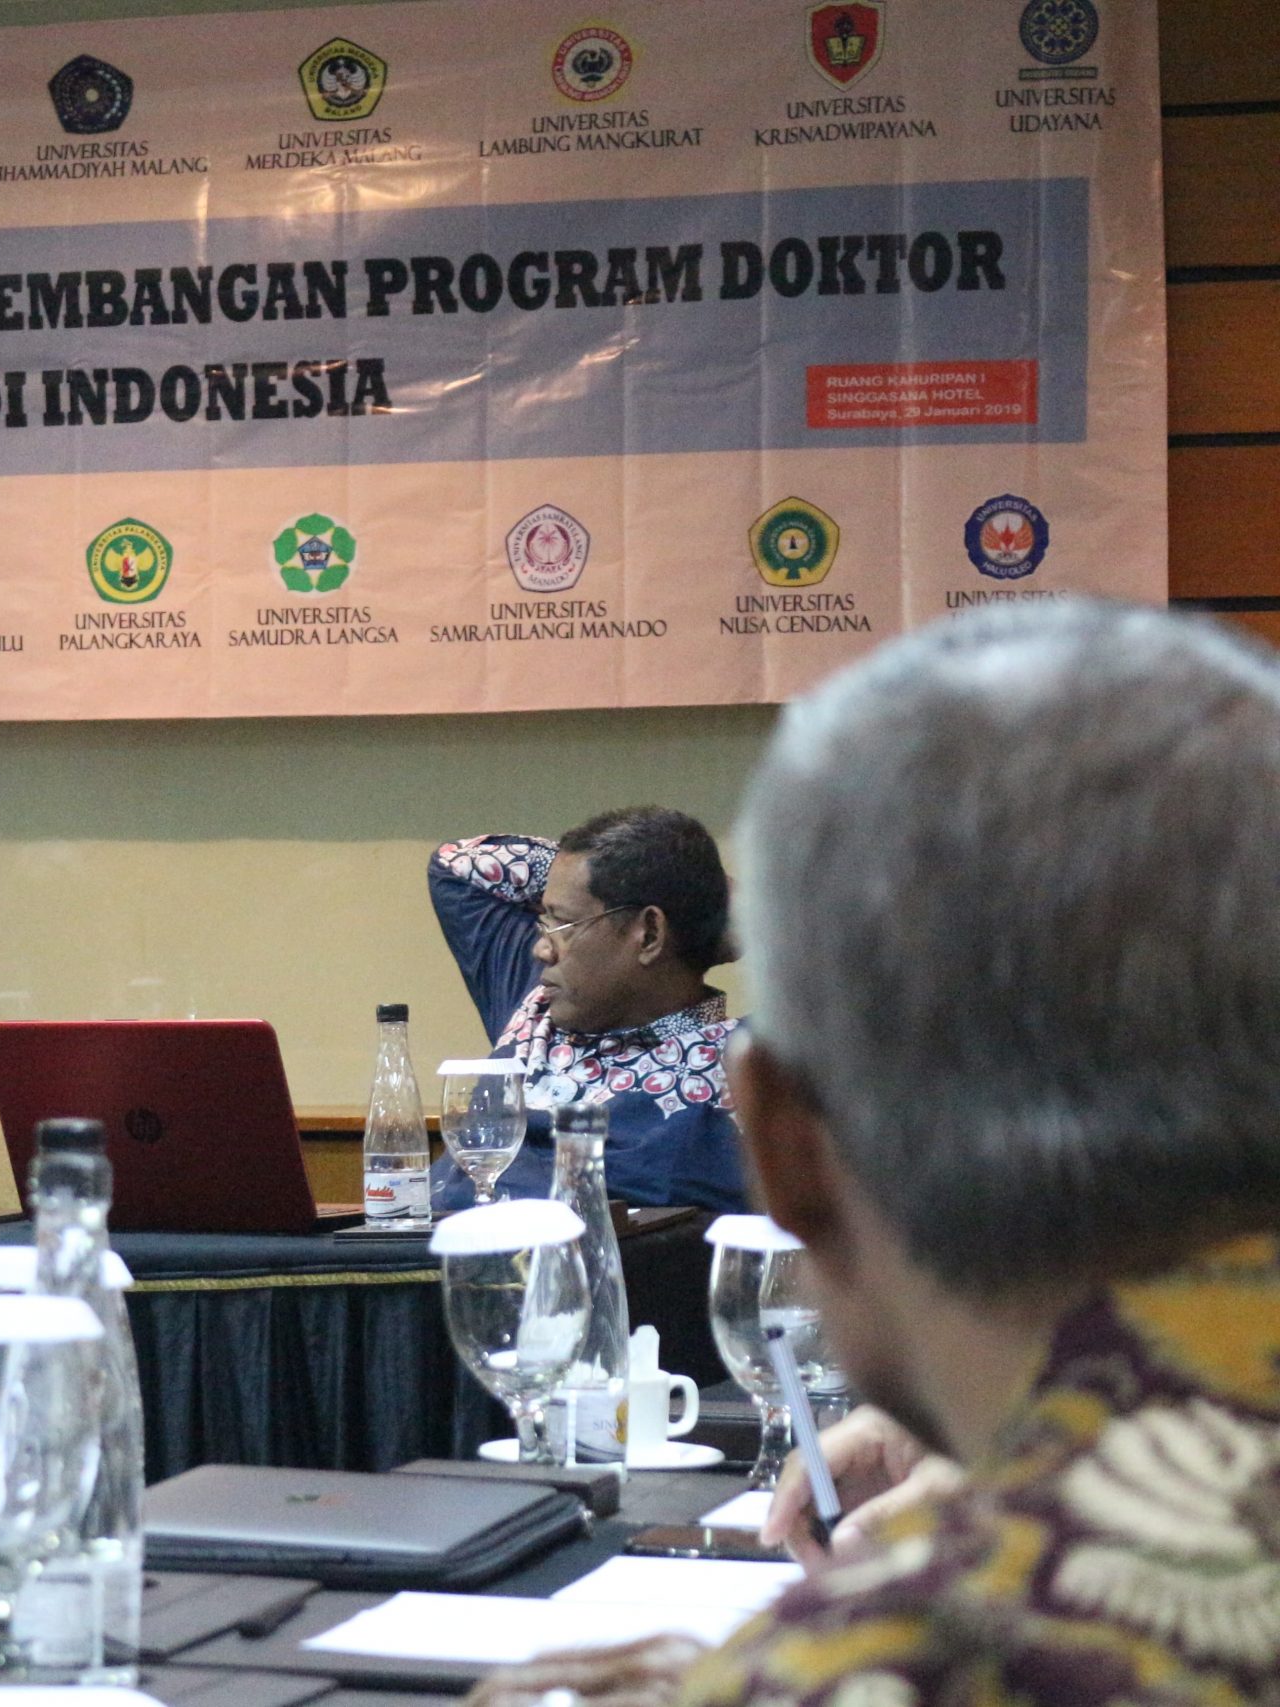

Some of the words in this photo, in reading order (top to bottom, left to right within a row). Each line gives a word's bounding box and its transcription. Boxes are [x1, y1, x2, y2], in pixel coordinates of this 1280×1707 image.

[787, 95, 907, 120] UNIVERSITAS
[995, 87, 1116, 108] UNIVERSITAS
[531, 109, 650, 133] UNIVERSITAS
[754, 119, 937, 146] KRISNADWIPAYANA
[1010, 112, 1102, 133] UDAYANA
[278, 126, 393, 149] UNIVERSITAS
[479, 134, 572, 157] LAMBUNG
[575, 127, 704, 151] MANGKURAT
[36, 140, 150, 161] UNIVERSITAS
[245, 149, 340, 171] MERDEKA
[340, 144, 423, 167] MALANG
[129, 156, 210, 178] MALANG
[364, 243, 704, 317] PROGRAM
[719, 230, 1006, 300] DOKTOR
[41, 357, 394, 426] INDONESIA
[826, 375, 883, 388] RUANG
[888, 373, 976, 386] KAHURIPAN
[827, 391, 928, 404] SINGGASANA
[932, 389, 984, 401] HOTEL
[924, 405, 981, 417] Januari
[984, 403, 1022, 415] 2019
[977, 499, 1038, 522] UNIVERSITAS
[490, 600, 607, 623] UNIVERSITAS
[736, 592, 856, 615] UNIVERSITAS
[74, 609, 187, 631] UNIVERSITAS
[257, 606, 373, 627] UNIVERSITAS
[720, 615, 772, 636] NUSA
[778, 613, 872, 634] CENDANA
[59, 630, 202, 651] PALANGKARAYA
[228, 626, 322, 648] SAMUDRA
[325, 625, 400, 646] LANGSA
[429, 622, 574, 643] SAMRATULANGI
[579, 619, 668, 639] MANADO
